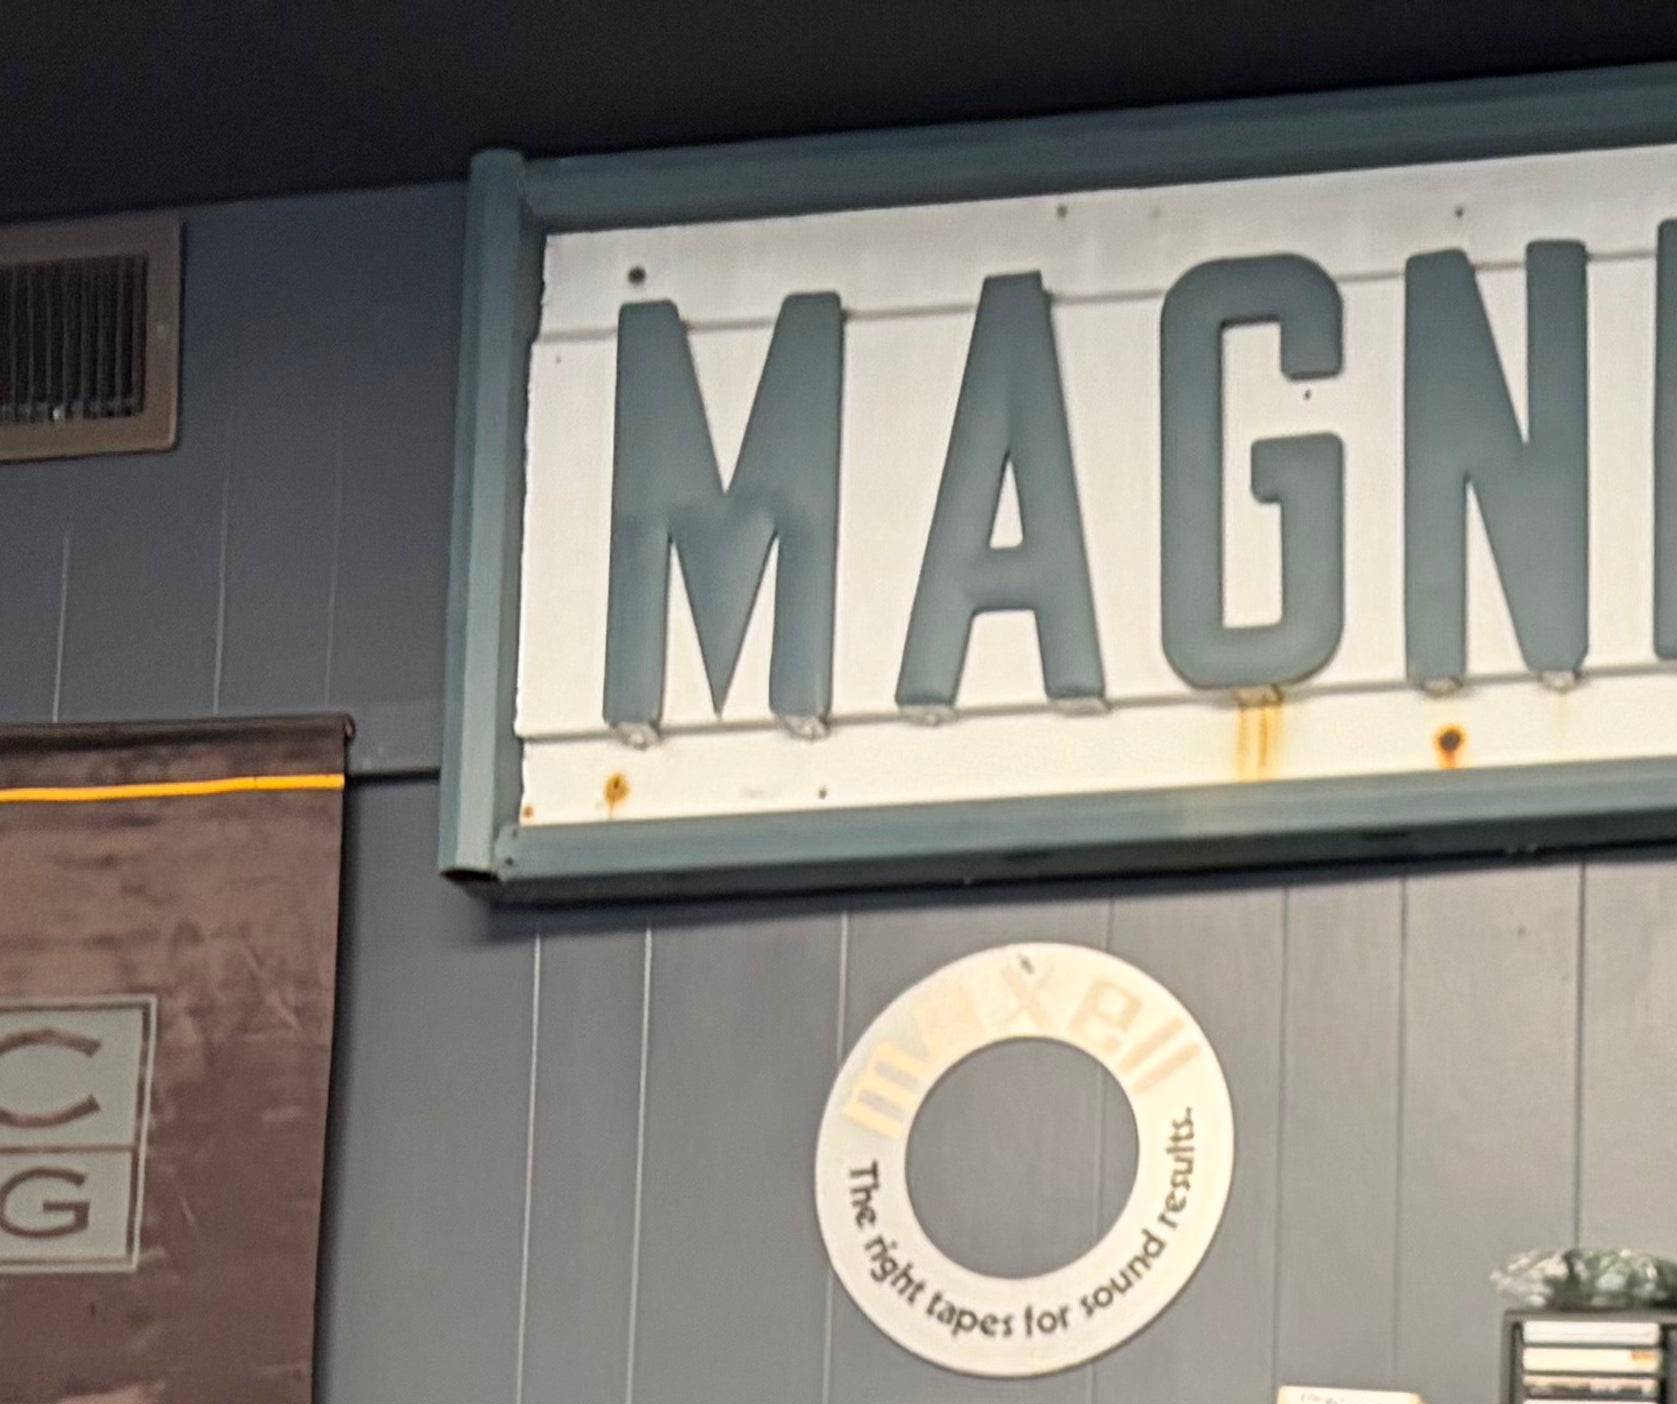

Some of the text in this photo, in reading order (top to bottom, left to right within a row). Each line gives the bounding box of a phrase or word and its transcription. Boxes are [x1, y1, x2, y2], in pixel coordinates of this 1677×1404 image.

[850, 1160, 878, 1228] The
[865, 1236, 925, 1304] right
[926, 1291, 1014, 1338] tapes
[1025, 1304, 1072, 1338] for
[1081, 1229, 1167, 1318] sound
